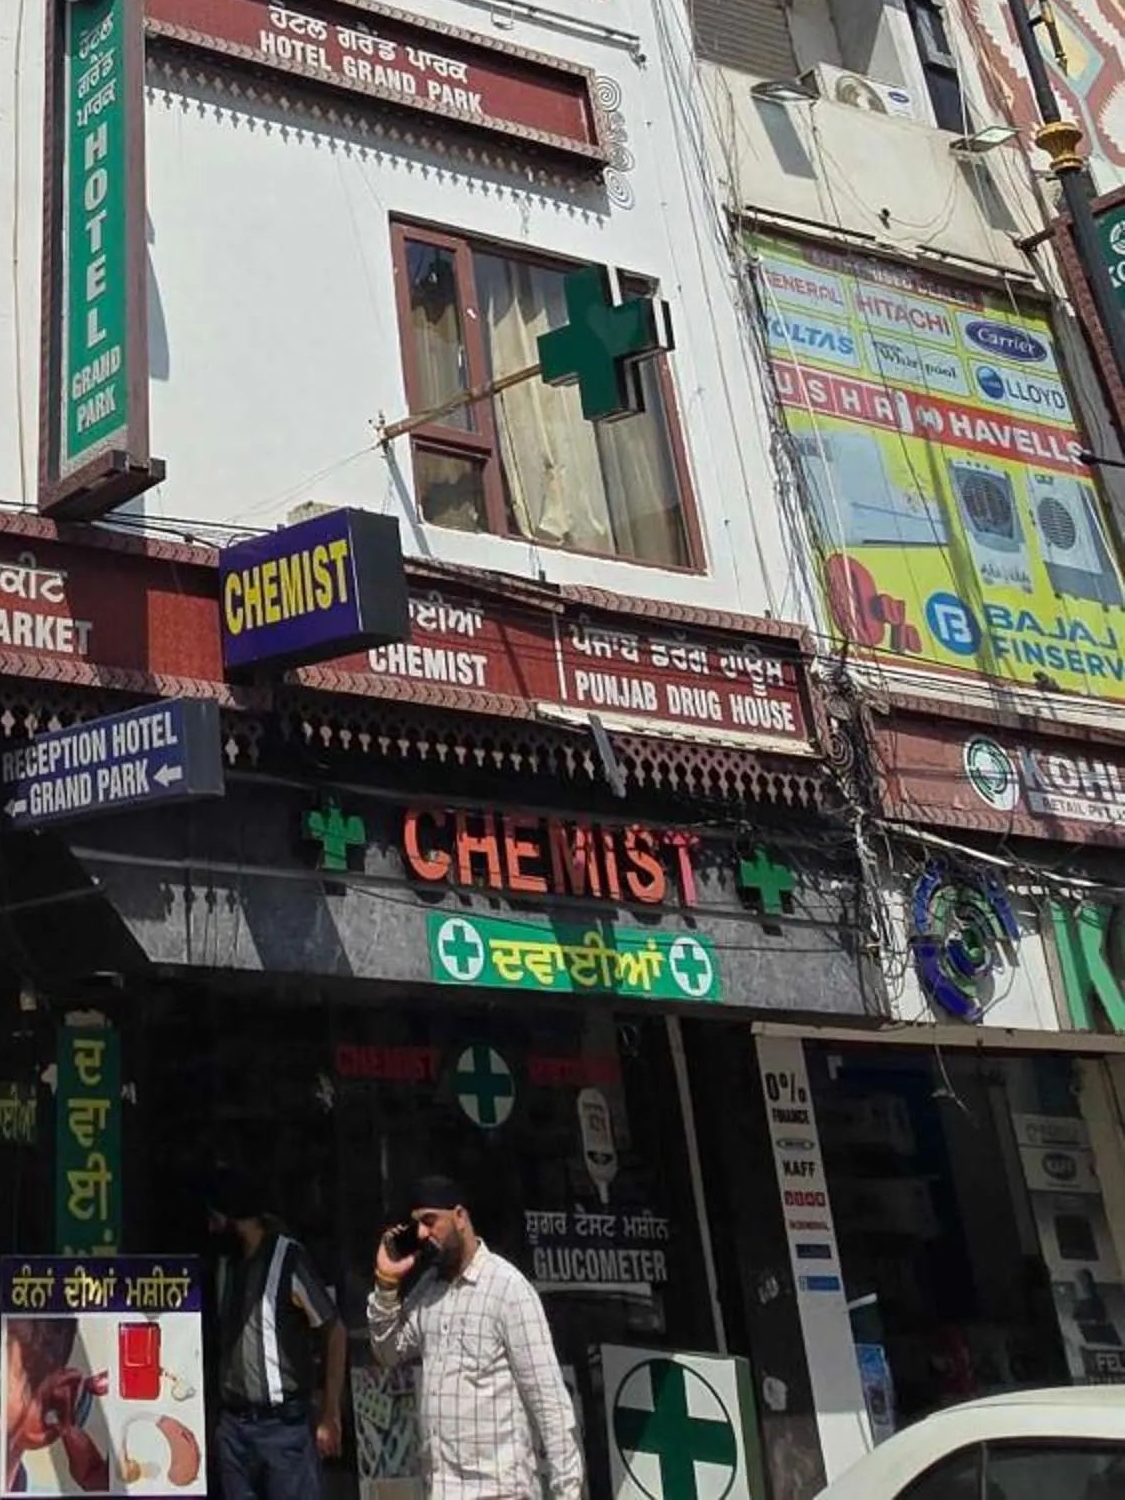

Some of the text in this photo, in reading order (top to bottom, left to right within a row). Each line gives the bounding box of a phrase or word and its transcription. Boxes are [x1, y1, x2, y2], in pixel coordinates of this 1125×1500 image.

[259, 30, 484, 115] HOTEL GRAND PARK
[405, 46, 468, 83] ਪਾਰਕ
[84, 121, 108, 348] HOTEL
[855, 292, 951, 337] HITACHI
[977, 327, 1036, 356] Carrier
[72, 345, 122, 401] GRAND
[769, 317, 854, 356] OLTAS
[1006, 379, 1066, 409] LLOYD
[77, 384, 116, 433] PARK
[775, 370, 1092, 467] USHA HAVELLS
[225, 538, 348, 636] CHEMIST
[982, 602, 1120, 650] BAJAJ
[368, 643, 488, 688] CHEMIST
[990, 635, 1125, 681] FINSERV
[576, 672, 796, 732] PUNJAB DRUG HOUSE
[2, 711, 178, 784] RECEPTION HOTEL
[30, 758, 150, 817] GRAND PARK
[402, 805, 701, 908] CHEMIST
[488, 931, 665, 990] ਦਵਾਈਆਂ
[532, 1246, 669, 1283] GLUCOMETER
